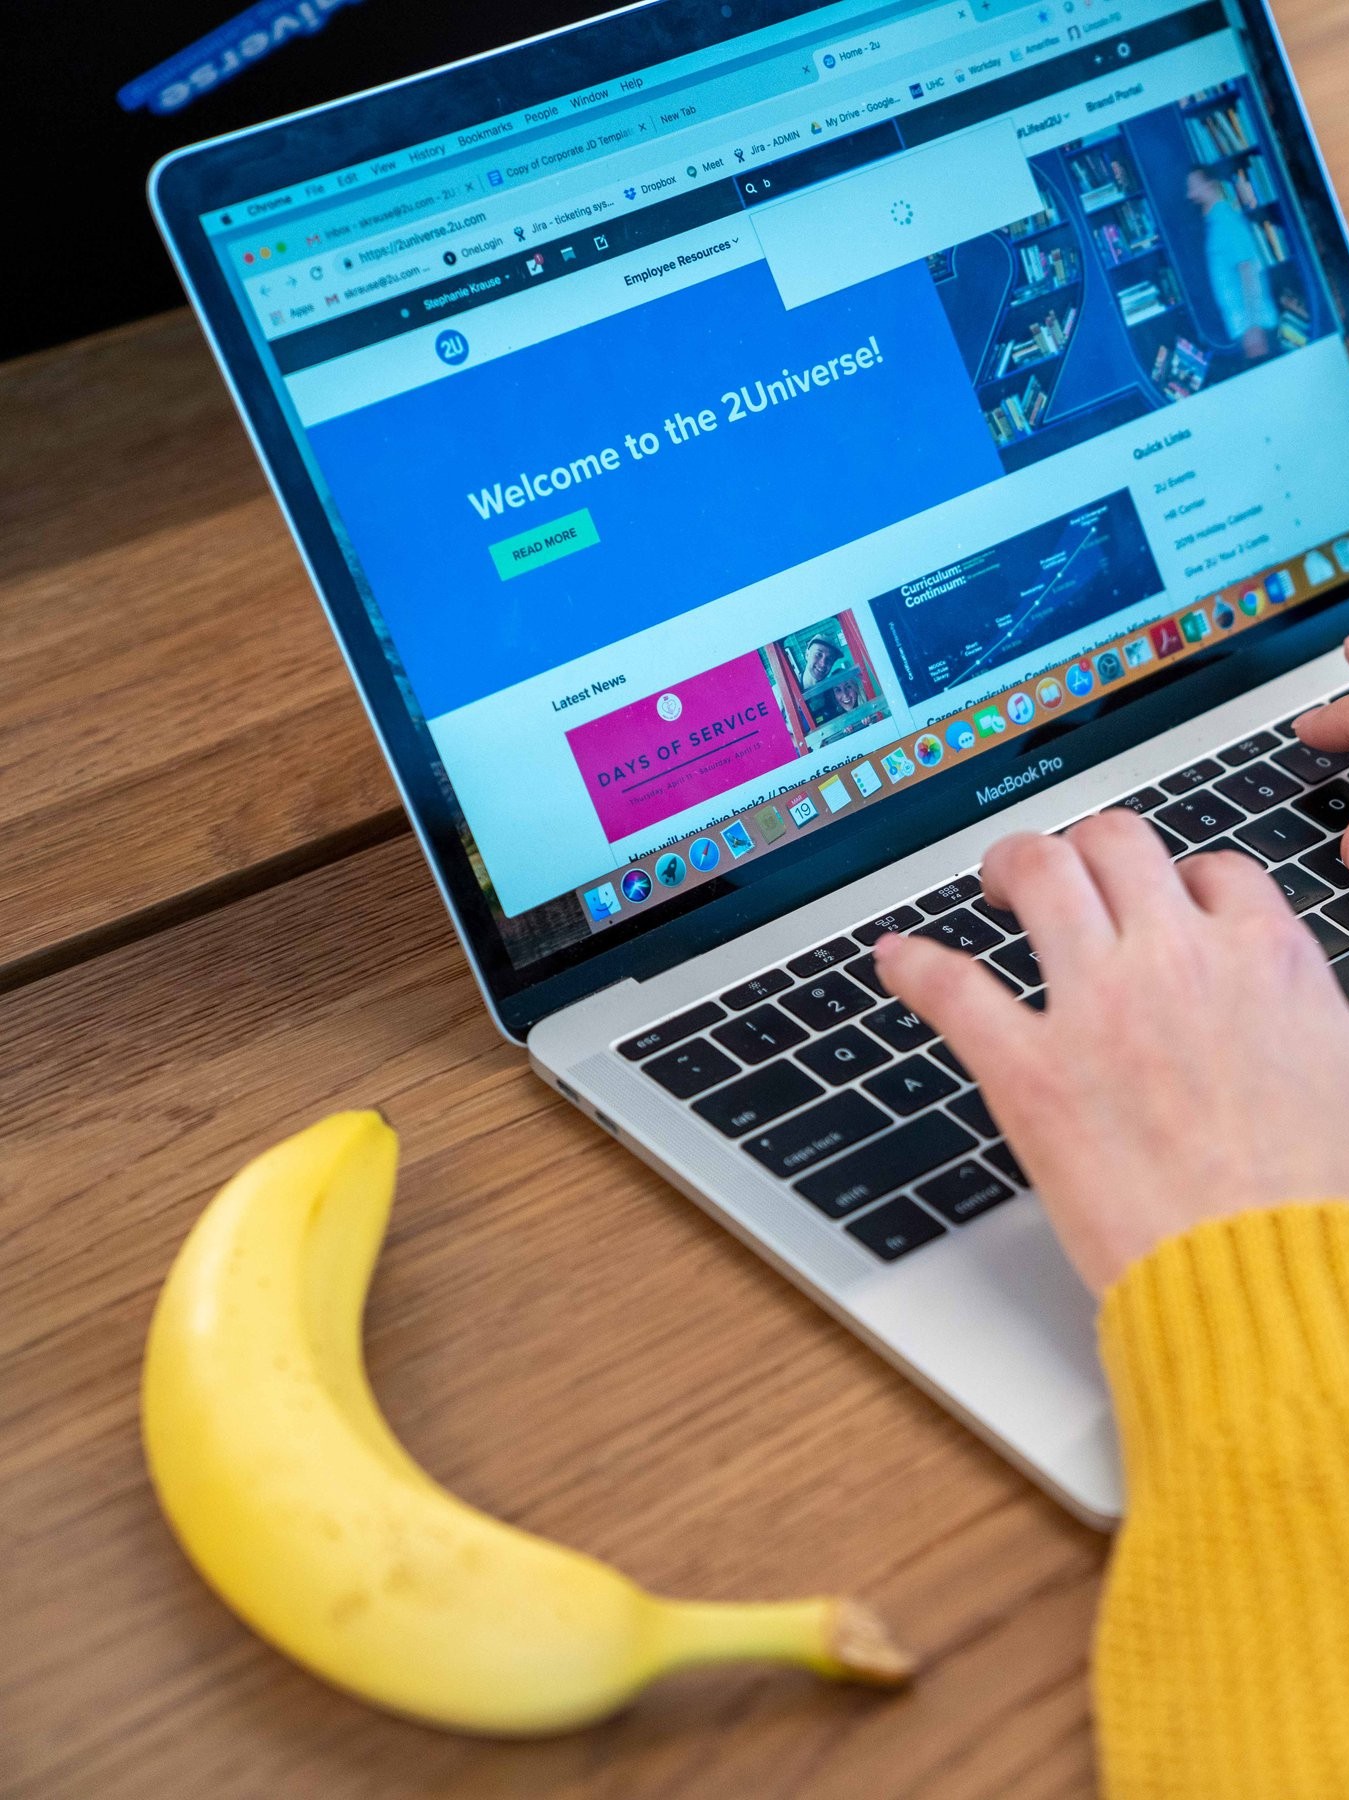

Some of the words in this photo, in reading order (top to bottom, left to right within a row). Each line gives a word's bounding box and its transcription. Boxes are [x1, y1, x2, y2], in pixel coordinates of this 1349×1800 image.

[839, 47, 863, 62] Home
[869, 40, 881, 51] 2u
[968, 56, 1002, 76] Workday
[925, 77, 946, 91] UHC
[1085, 94, 1114, 114] Brand
[1114, 82, 1144, 101] Portal
[660, 112, 680, 125] New
[681, 105, 697, 117] Tab
[825, 116, 839, 128] My
[839, 109, 860, 123] Drive
[866, 95, 902, 113] Google...
[247, 195, 293, 216] Chrome
[305, 184, 325, 197] File
[337, 172, 359, 188] Edit
[371, 160, 397, 176] View
[408, 144, 446, 164] History
[457, 120, 514, 148] Bookmarks
[524, 105, 559, 125] People
[570, 88, 610, 109] Window
[619, 76, 645, 93] Help
[750, 143, 766, 156] Jira
[772, 130, 801, 148] ADMIN
[507, 164, 529, 179] Copy
[531, 158, 540, 170] of
[541, 144, 585, 167] Corporate
[586, 140, 598, 151] JD
[702, 158, 724, 173] Meet
[640, 175, 677, 196] Dropbox
[763, 178, 772, 188] b
[531, 222, 548, 234] Jira
[554, 207, 592, 226] ticketing
[592, 200, 615, 213] sys...
[358, 210, 487, 264] https://2universe.2u.com
[461, 236, 504, 259] OneLogin
[623, 261, 678, 288] Employee
[677, 239, 732, 267] Resources
[423, 284, 470, 311] Stephanie
[469, 274, 502, 296] Krause
[440, 336, 464, 359] 2U
[467, 446, 621, 521] Welcome
[624, 432, 660, 461] to
[664, 409, 719, 446] the
[720, 335, 884, 423] 2Universe!
[1133, 440, 1164, 460] Quick
[1163, 428, 1192, 448] Links
[511, 541, 544, 562] READ
[544, 527, 578, 548] MORE
[901, 564, 963, 597] Curriculum:
[904, 575, 967, 608] Continuum:
[552, 690, 593, 713] Latest
[594, 673, 628, 695] News
[597, 754, 651, 788] DAYS
[656, 740, 682, 762] OF
[688, 701, 771, 748] SERVICE
[975, 766, 1040, 806] MacBook
[1038, 756, 1064, 777] Pro
[1258, 786, 1275, 798] 9
[790, 794, 803, 805] MAR
[795, 802, 811, 819] 19
[1328, 799, 1346, 811] O
[1200, 815, 1217, 827] 8
[951, 892, 963, 901] F4
[1283, 884, 1296, 897] J
[887, 922, 900, 933] F3
[959, 935, 974, 948] 4
[827, 999, 846, 1014] 2
[896, 1012, 921, 1030] W
[635, 1034, 661, 1050] esc
[760, 1032, 777, 1047] 1
[833, 1047, 857, 1063] Q
[902, 1077, 924, 1094] A
[730, 1109, 758, 1128] tab
[782, 1147, 810, 1168] caps
[811, 1130, 845, 1153] lock
[834, 1184, 871, 1208] shift
[953, 1182, 1003, 1216] control
